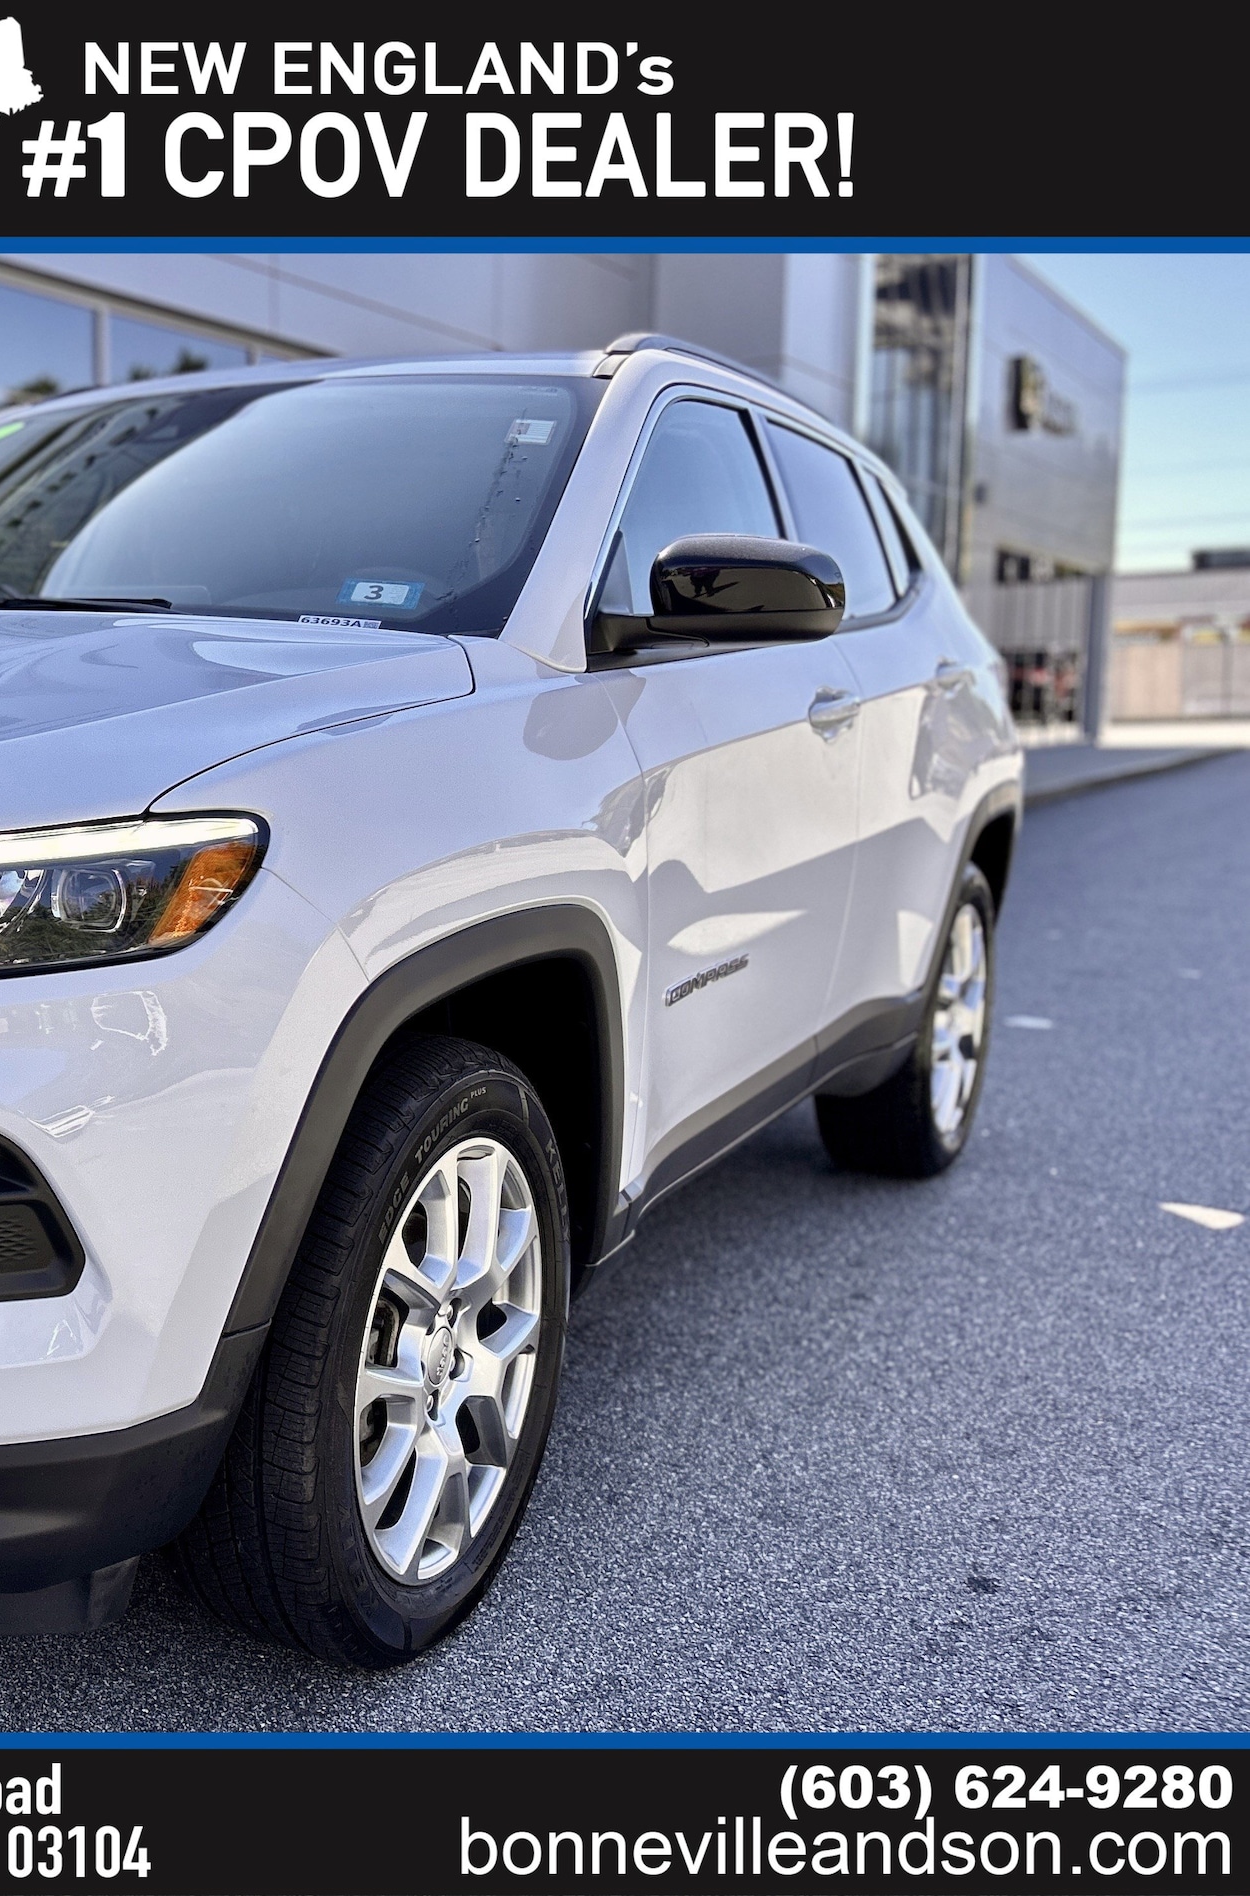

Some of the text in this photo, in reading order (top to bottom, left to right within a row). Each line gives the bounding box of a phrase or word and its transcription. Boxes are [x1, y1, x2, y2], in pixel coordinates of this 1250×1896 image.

[363, 584, 384, 601] 3
[301, 616, 362, 628] 63693A
[414, 1097, 470, 1165] TOURING
[469, 1086, 487, 1100] PLUS
